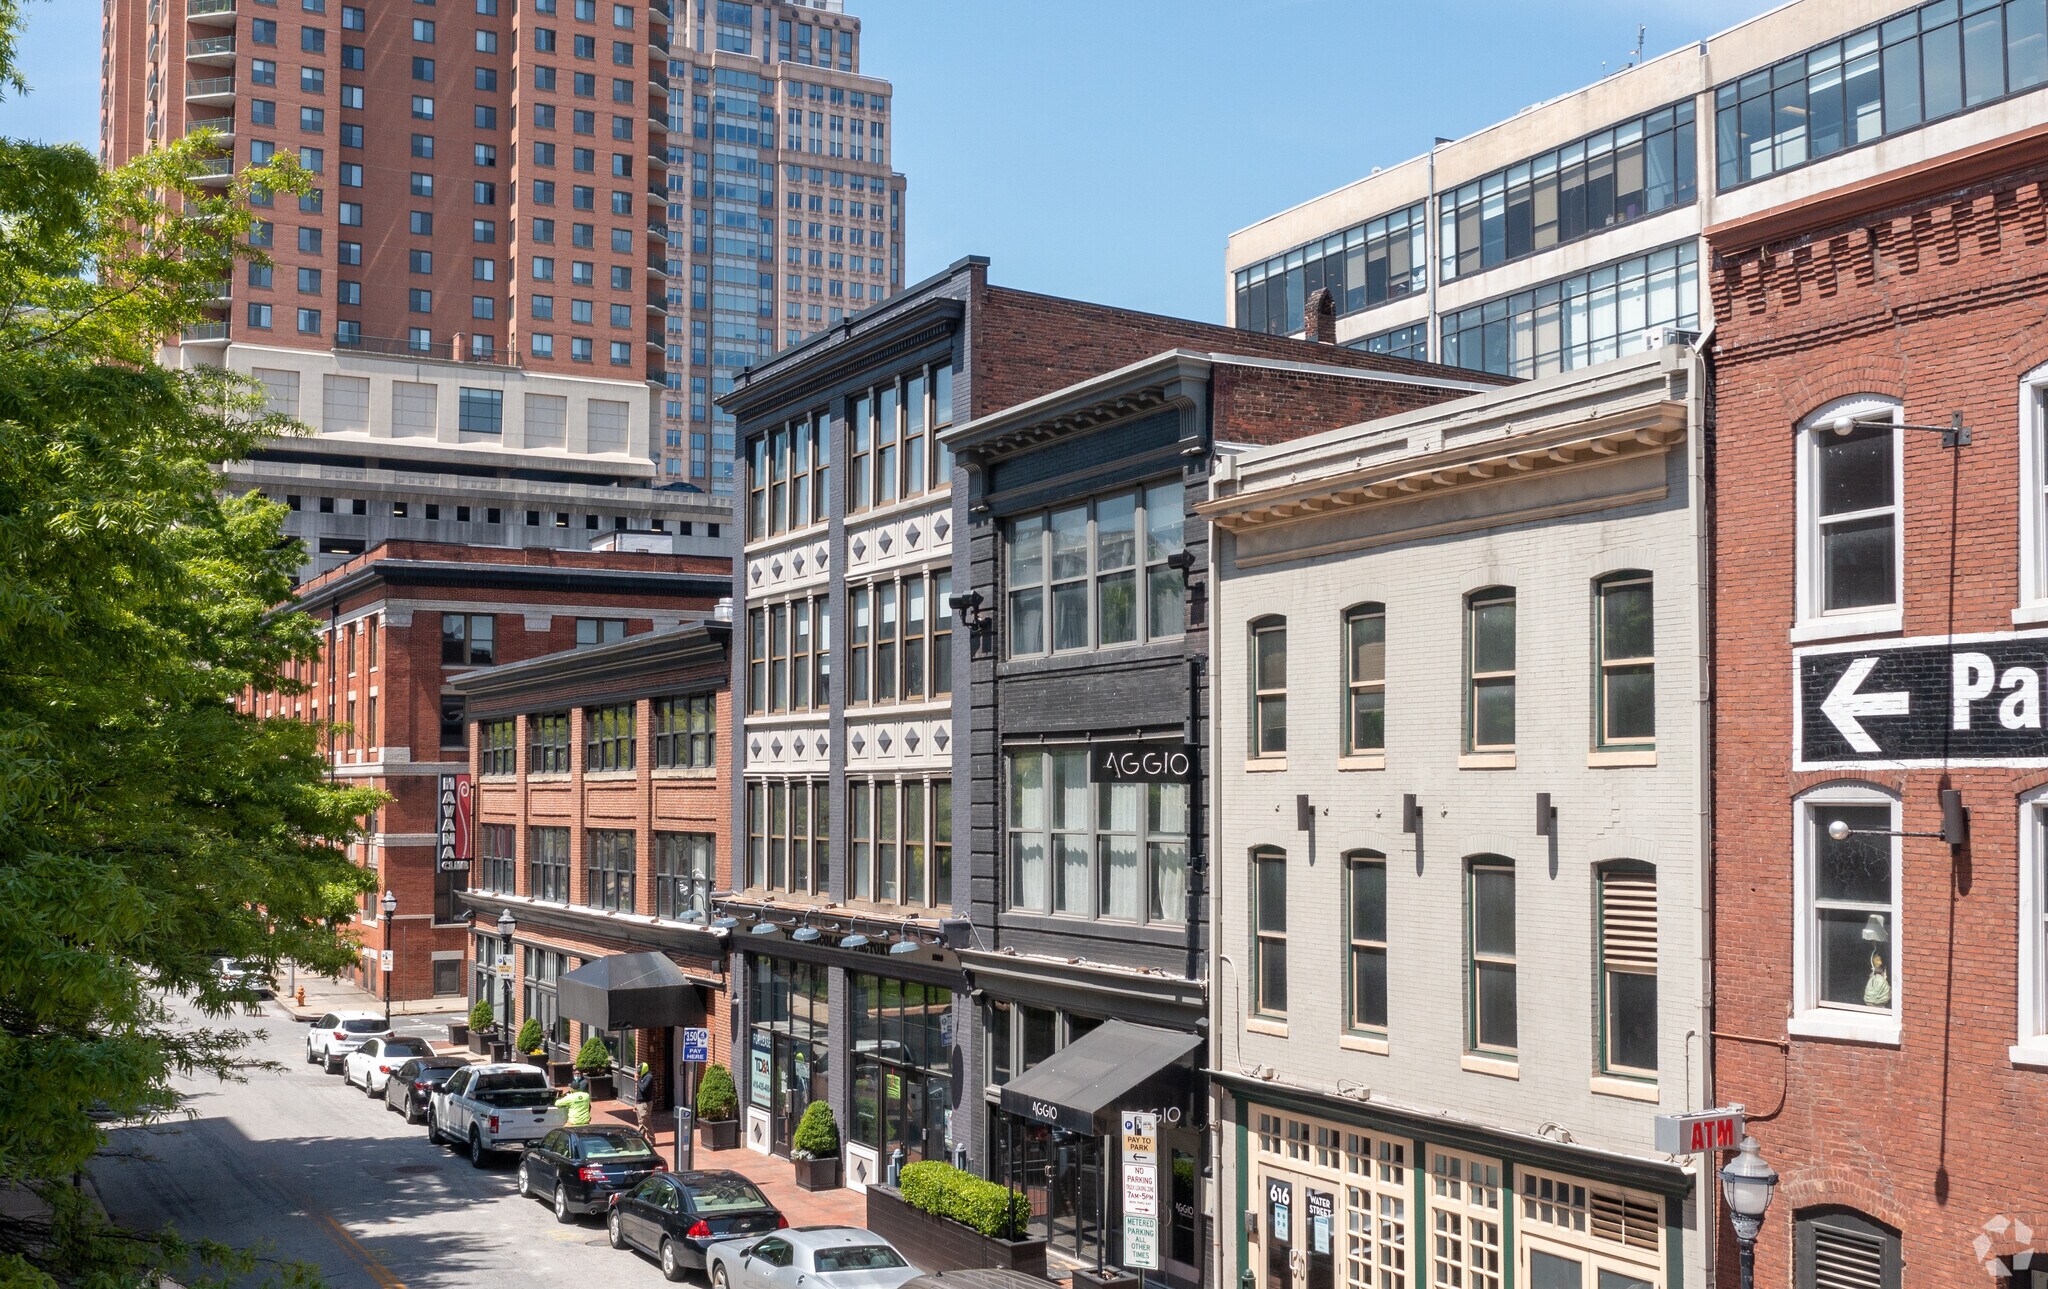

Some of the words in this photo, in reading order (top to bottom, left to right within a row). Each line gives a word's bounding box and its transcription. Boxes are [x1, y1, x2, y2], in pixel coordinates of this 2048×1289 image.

[1952, 652, 2048, 730] Pa
[1103, 752, 1189, 778] AGGIO
[442, 777, 456, 859] HAVANA
[441, 860, 469, 871] CLUB
[1032, 1101, 1058, 1120] AGGIO
[1127, 1136, 1139, 1144] PAY
[1141, 1137, 1151, 1145] TO
[1692, 1119, 1733, 1151] ATM
[1130, 1143, 1149, 1152] PARK
[1134, 1167, 1144, 1175] NO
[1127, 1175, 1153, 1185] PARKING
[1127, 1191, 1154, 1201] 7AM-5PM
[1270, 1184, 1290, 1205] 616
[1309, 1195, 1331, 1208] WATER
[1175, 1202, 1194, 1216] AGGIO
[1309, 1205, 1332, 1218] STREET
[1127, 1218, 1154, 1228] METERED
[1127, 1227, 1154, 1238] PARKING
[1135, 1236, 1146, 1245] ALL
[1131, 1243, 1151, 1253] OTHER
[1132, 1251, 1149, 1261] TIMES
